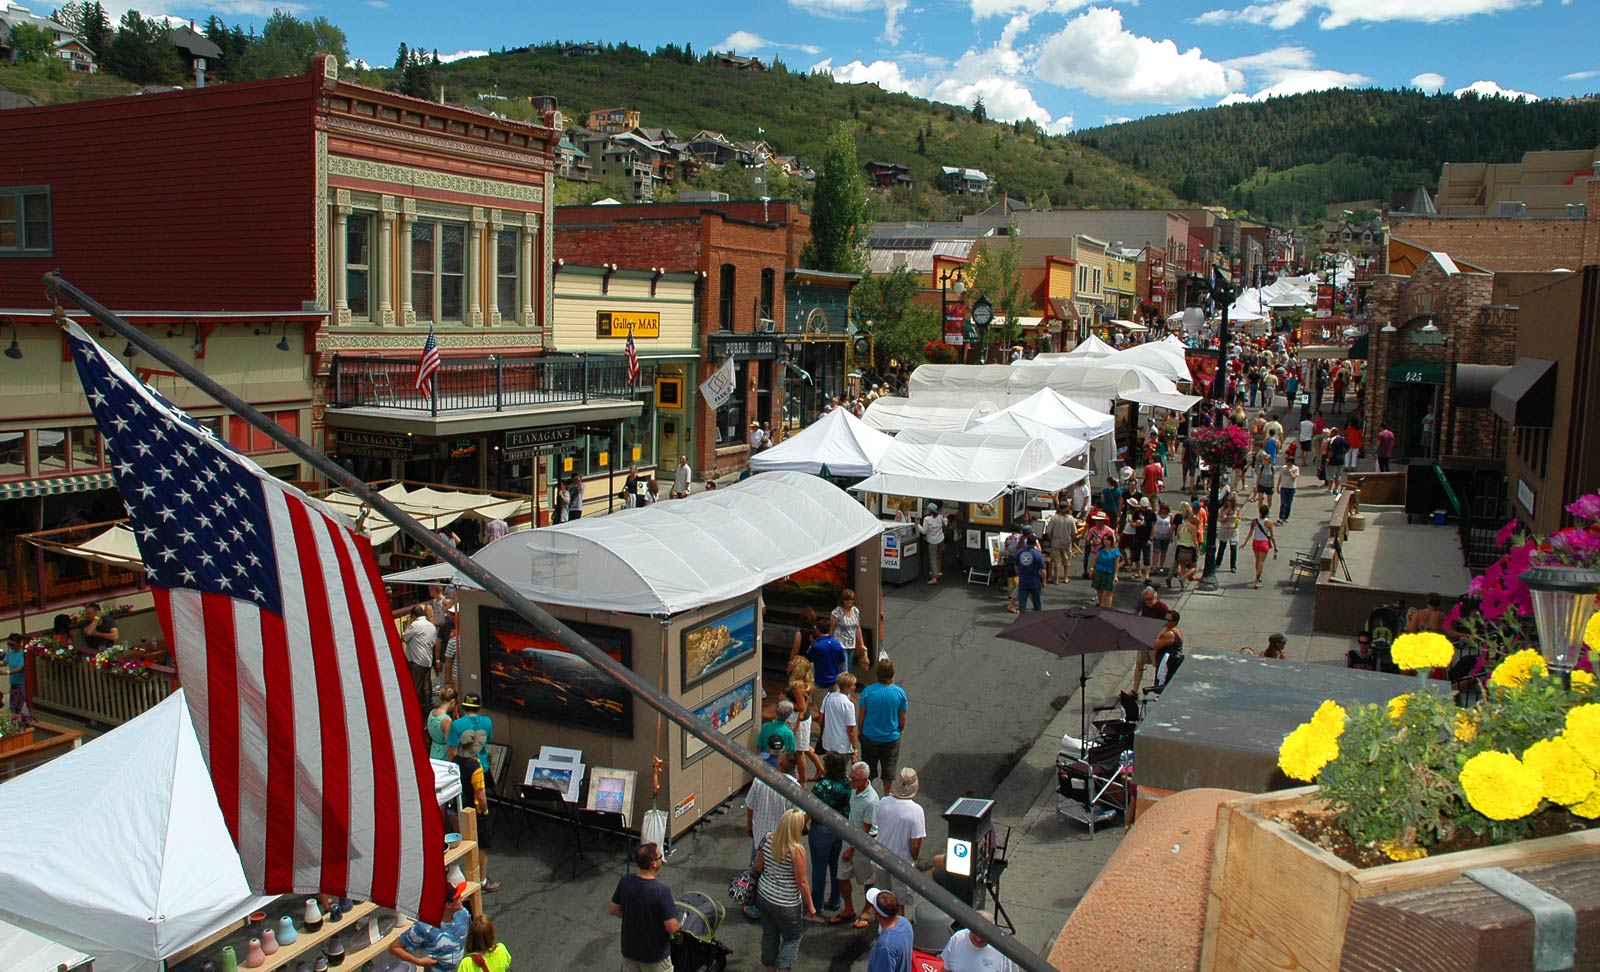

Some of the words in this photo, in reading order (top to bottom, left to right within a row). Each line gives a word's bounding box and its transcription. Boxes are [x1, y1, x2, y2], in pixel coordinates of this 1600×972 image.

[613, 317, 637, 332] Gallery
[638, 318, 657, 330] MAR
[725, 342, 749, 354] PURPLE
[757, 341, 772, 353] SAGE
[1405, 372, 1422, 382] 425
[714, 391, 727, 403] PARK
[344, 432, 404, 447] FLANAGAN'S
[512, 429, 570, 445] FLANAGAN'S
